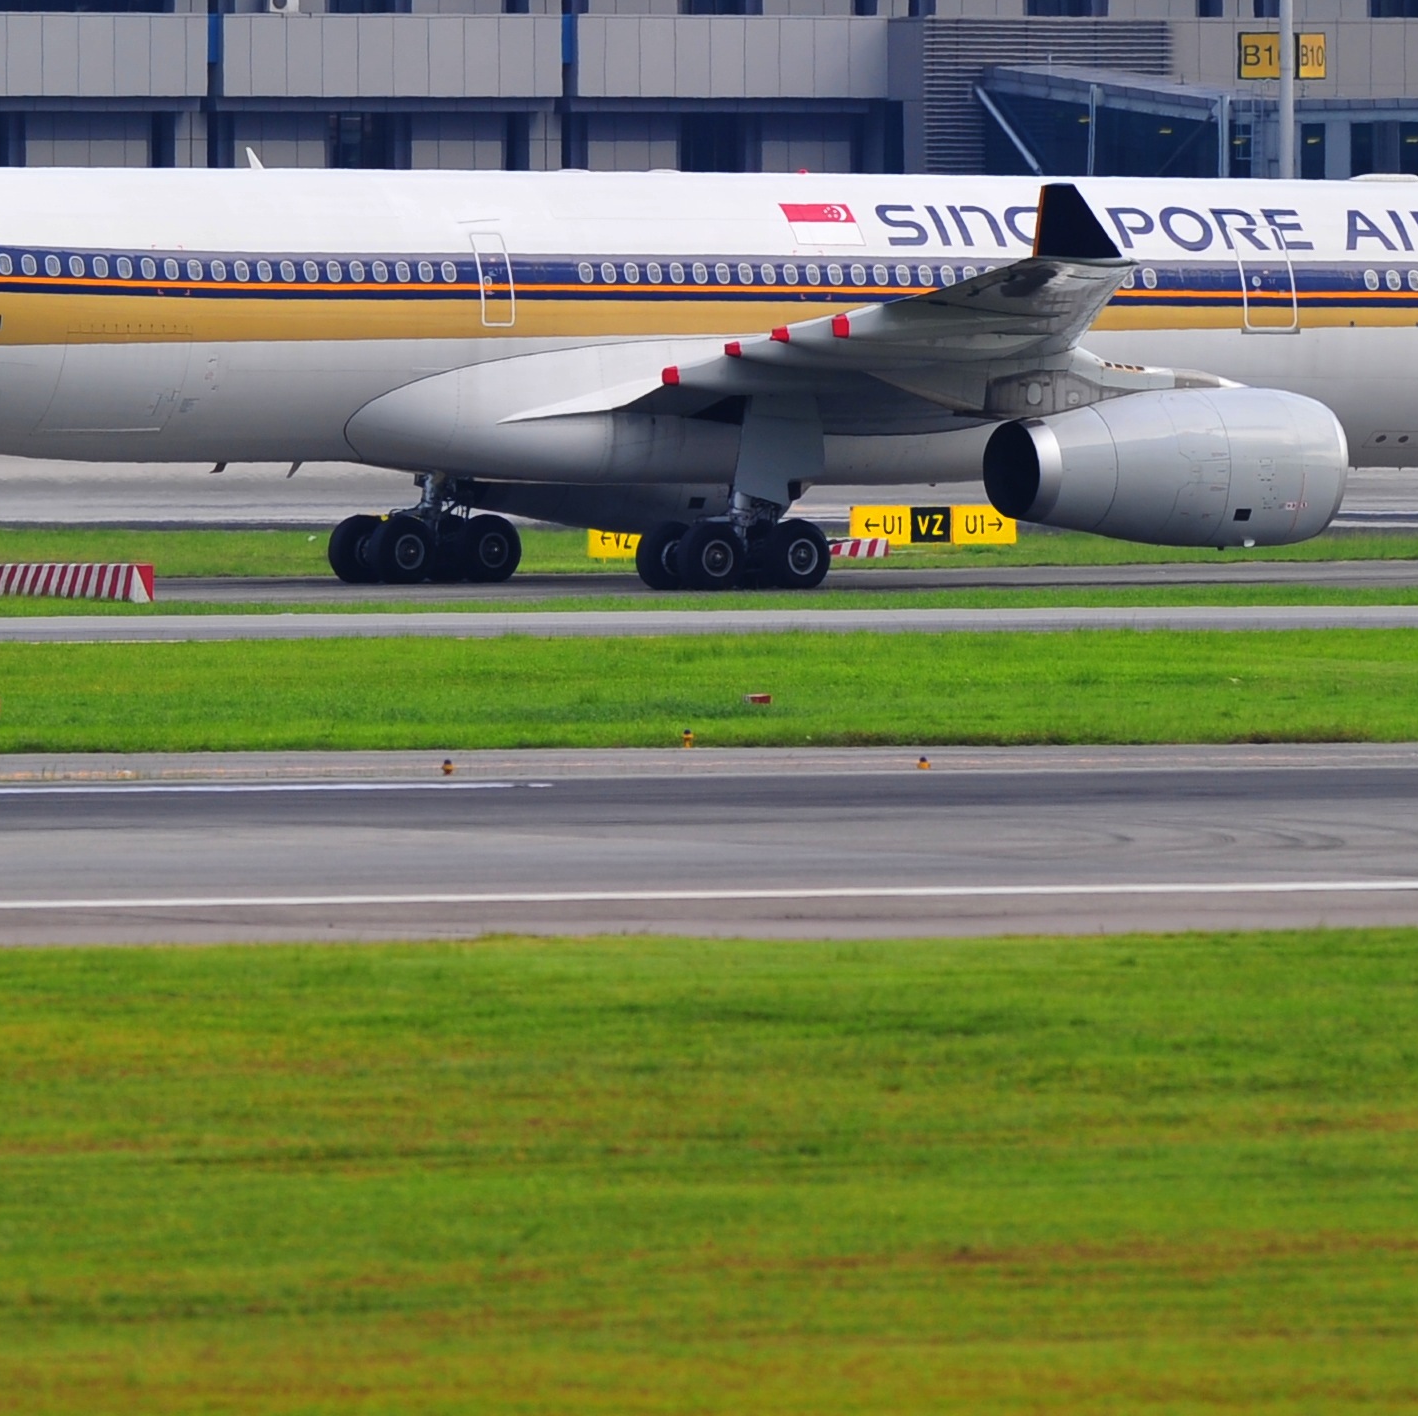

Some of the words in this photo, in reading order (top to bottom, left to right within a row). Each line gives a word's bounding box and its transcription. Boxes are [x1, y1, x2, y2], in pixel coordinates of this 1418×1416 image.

[1243, 44, 1280, 66] B1
[1300, 44, 1324, 67] B10
[883, 515, 902, 535] U1
